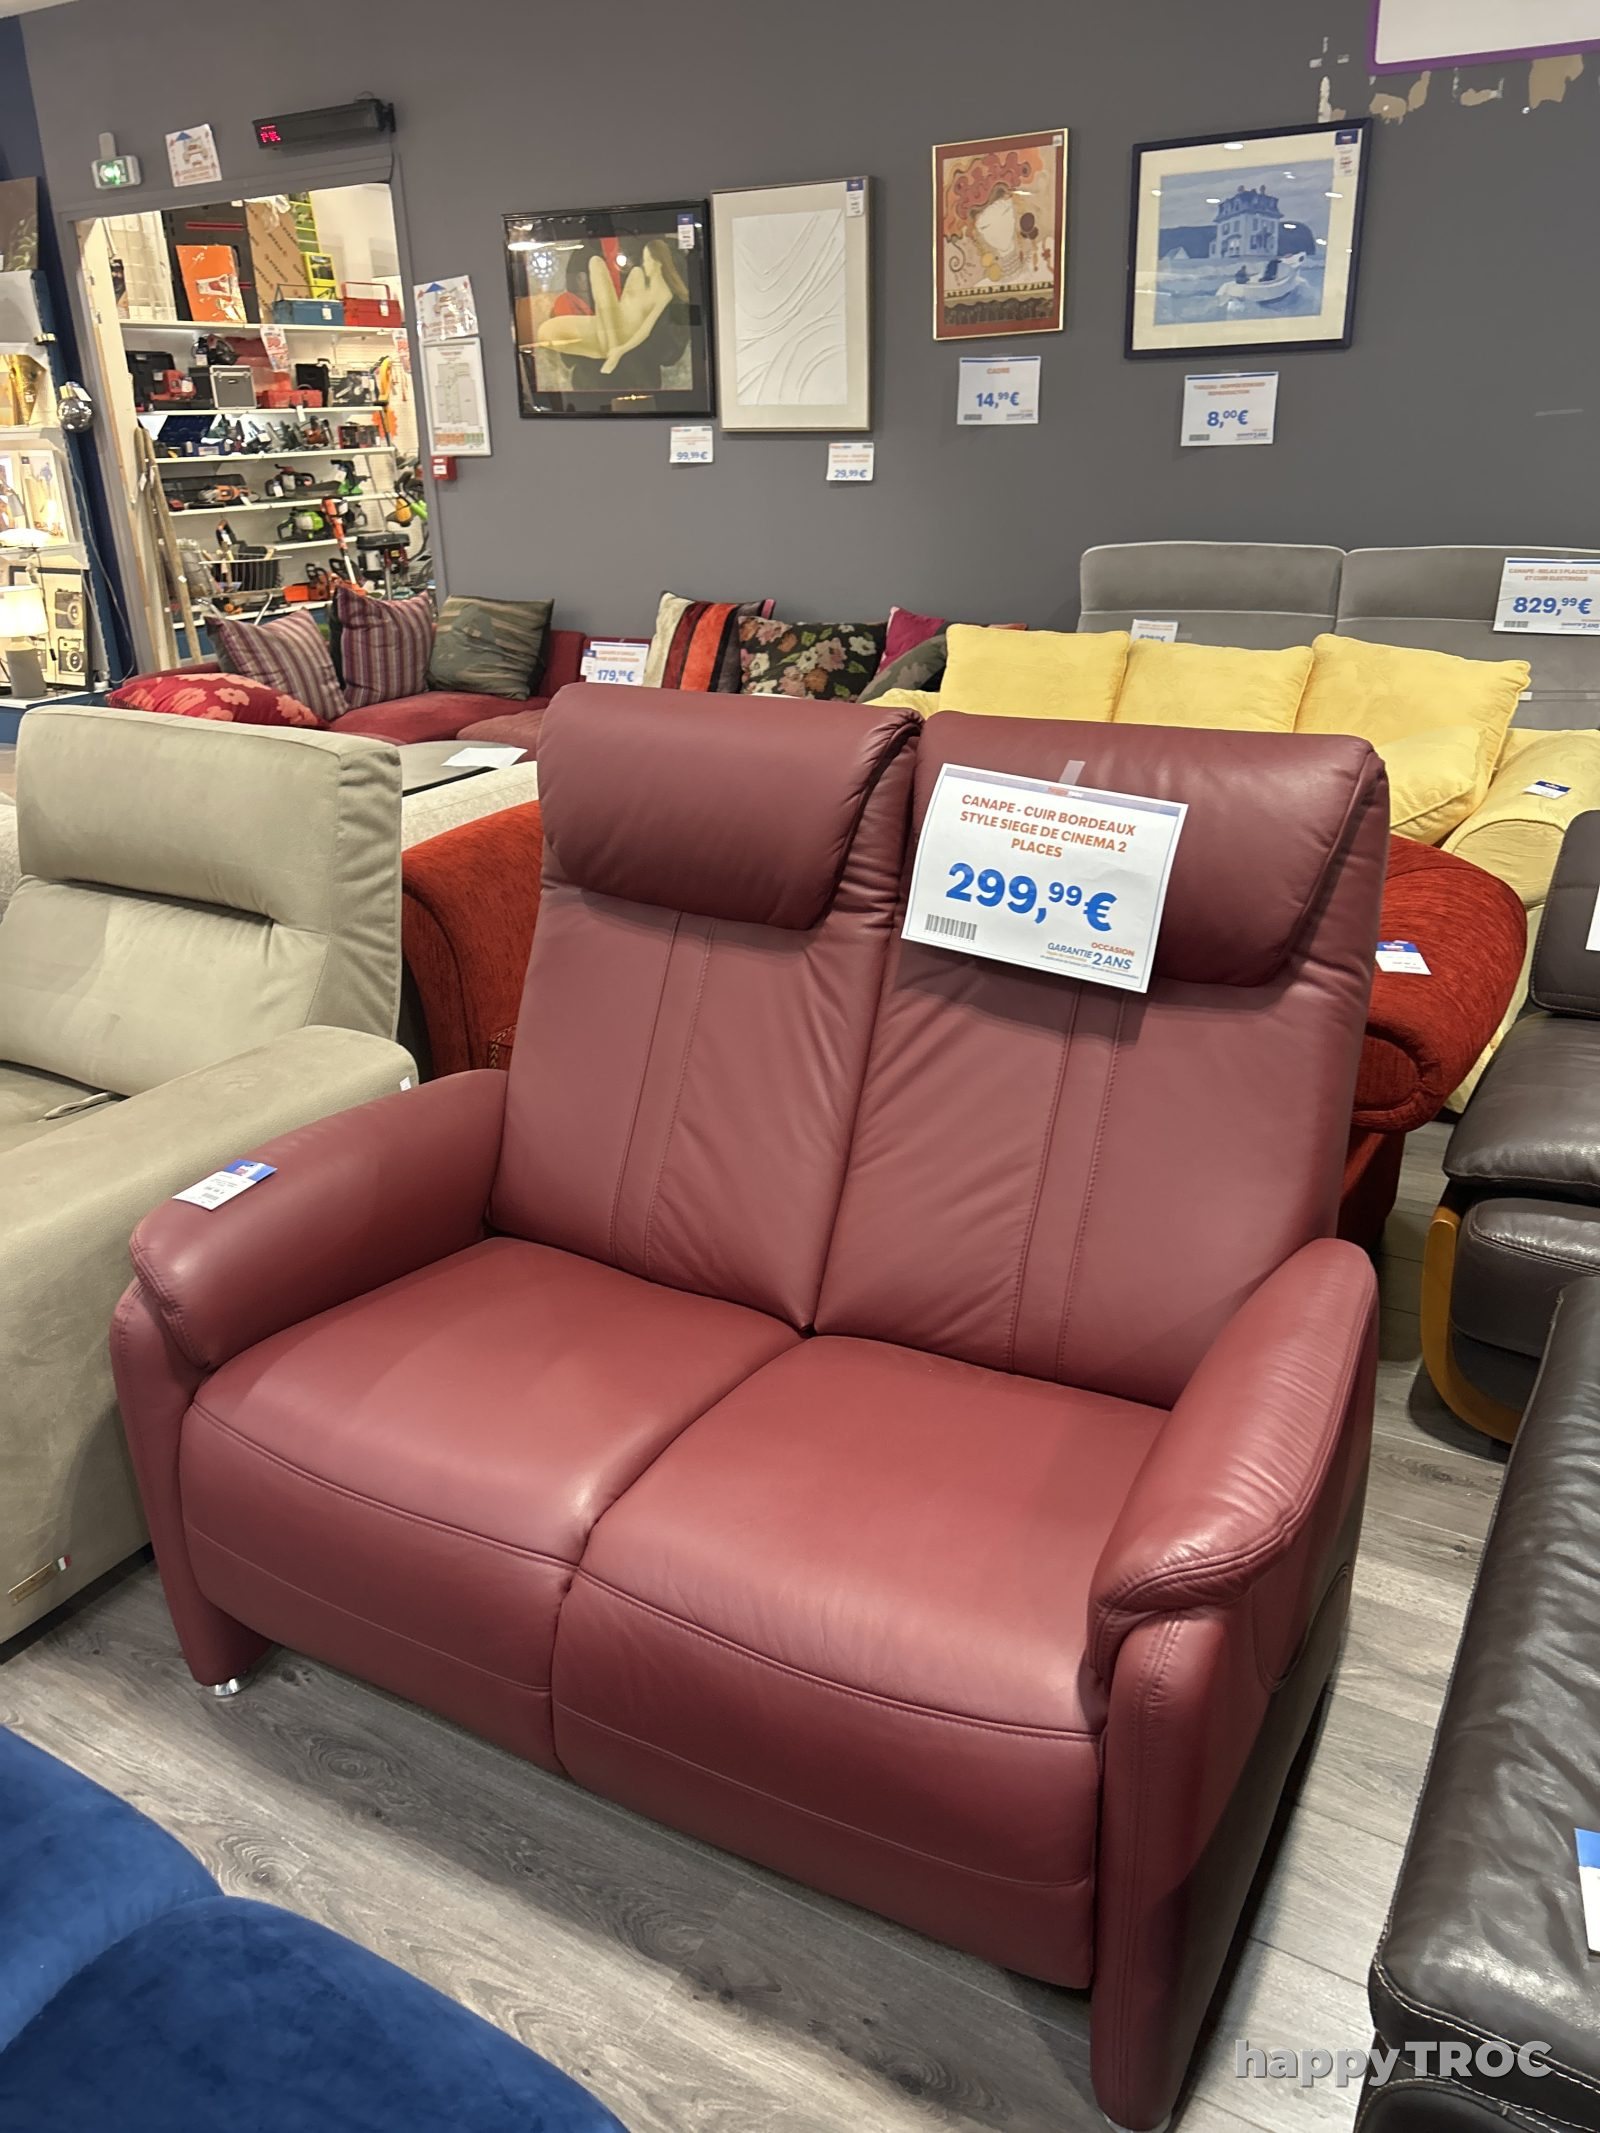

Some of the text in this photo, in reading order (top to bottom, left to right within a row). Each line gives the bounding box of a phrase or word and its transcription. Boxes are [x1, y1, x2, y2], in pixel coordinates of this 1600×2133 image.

[976, 391, 1020, 409] 14,99€
[1207, 409, 1249, 429] 8,00€
[1513, 596, 1593, 617] 829,99€
[961, 794, 1015, 813] CANAPE
[1024, 806, 1057, 822] CUIR
[1057, 812, 1137, 836] BORDEAUX
[959, 810, 1127, 853] STYLE SIEGE DE CINEMA 2
[1010, 838, 1063, 858] PLACES
[945, 862, 1118, 932] 299,99€
[1047, 942, 1093, 959] GARANTIE
[1092, 953, 1103, 966] 2
[1102, 957, 1133, 970] ANS
[1090, 942, 1135, 957] OCCASION
